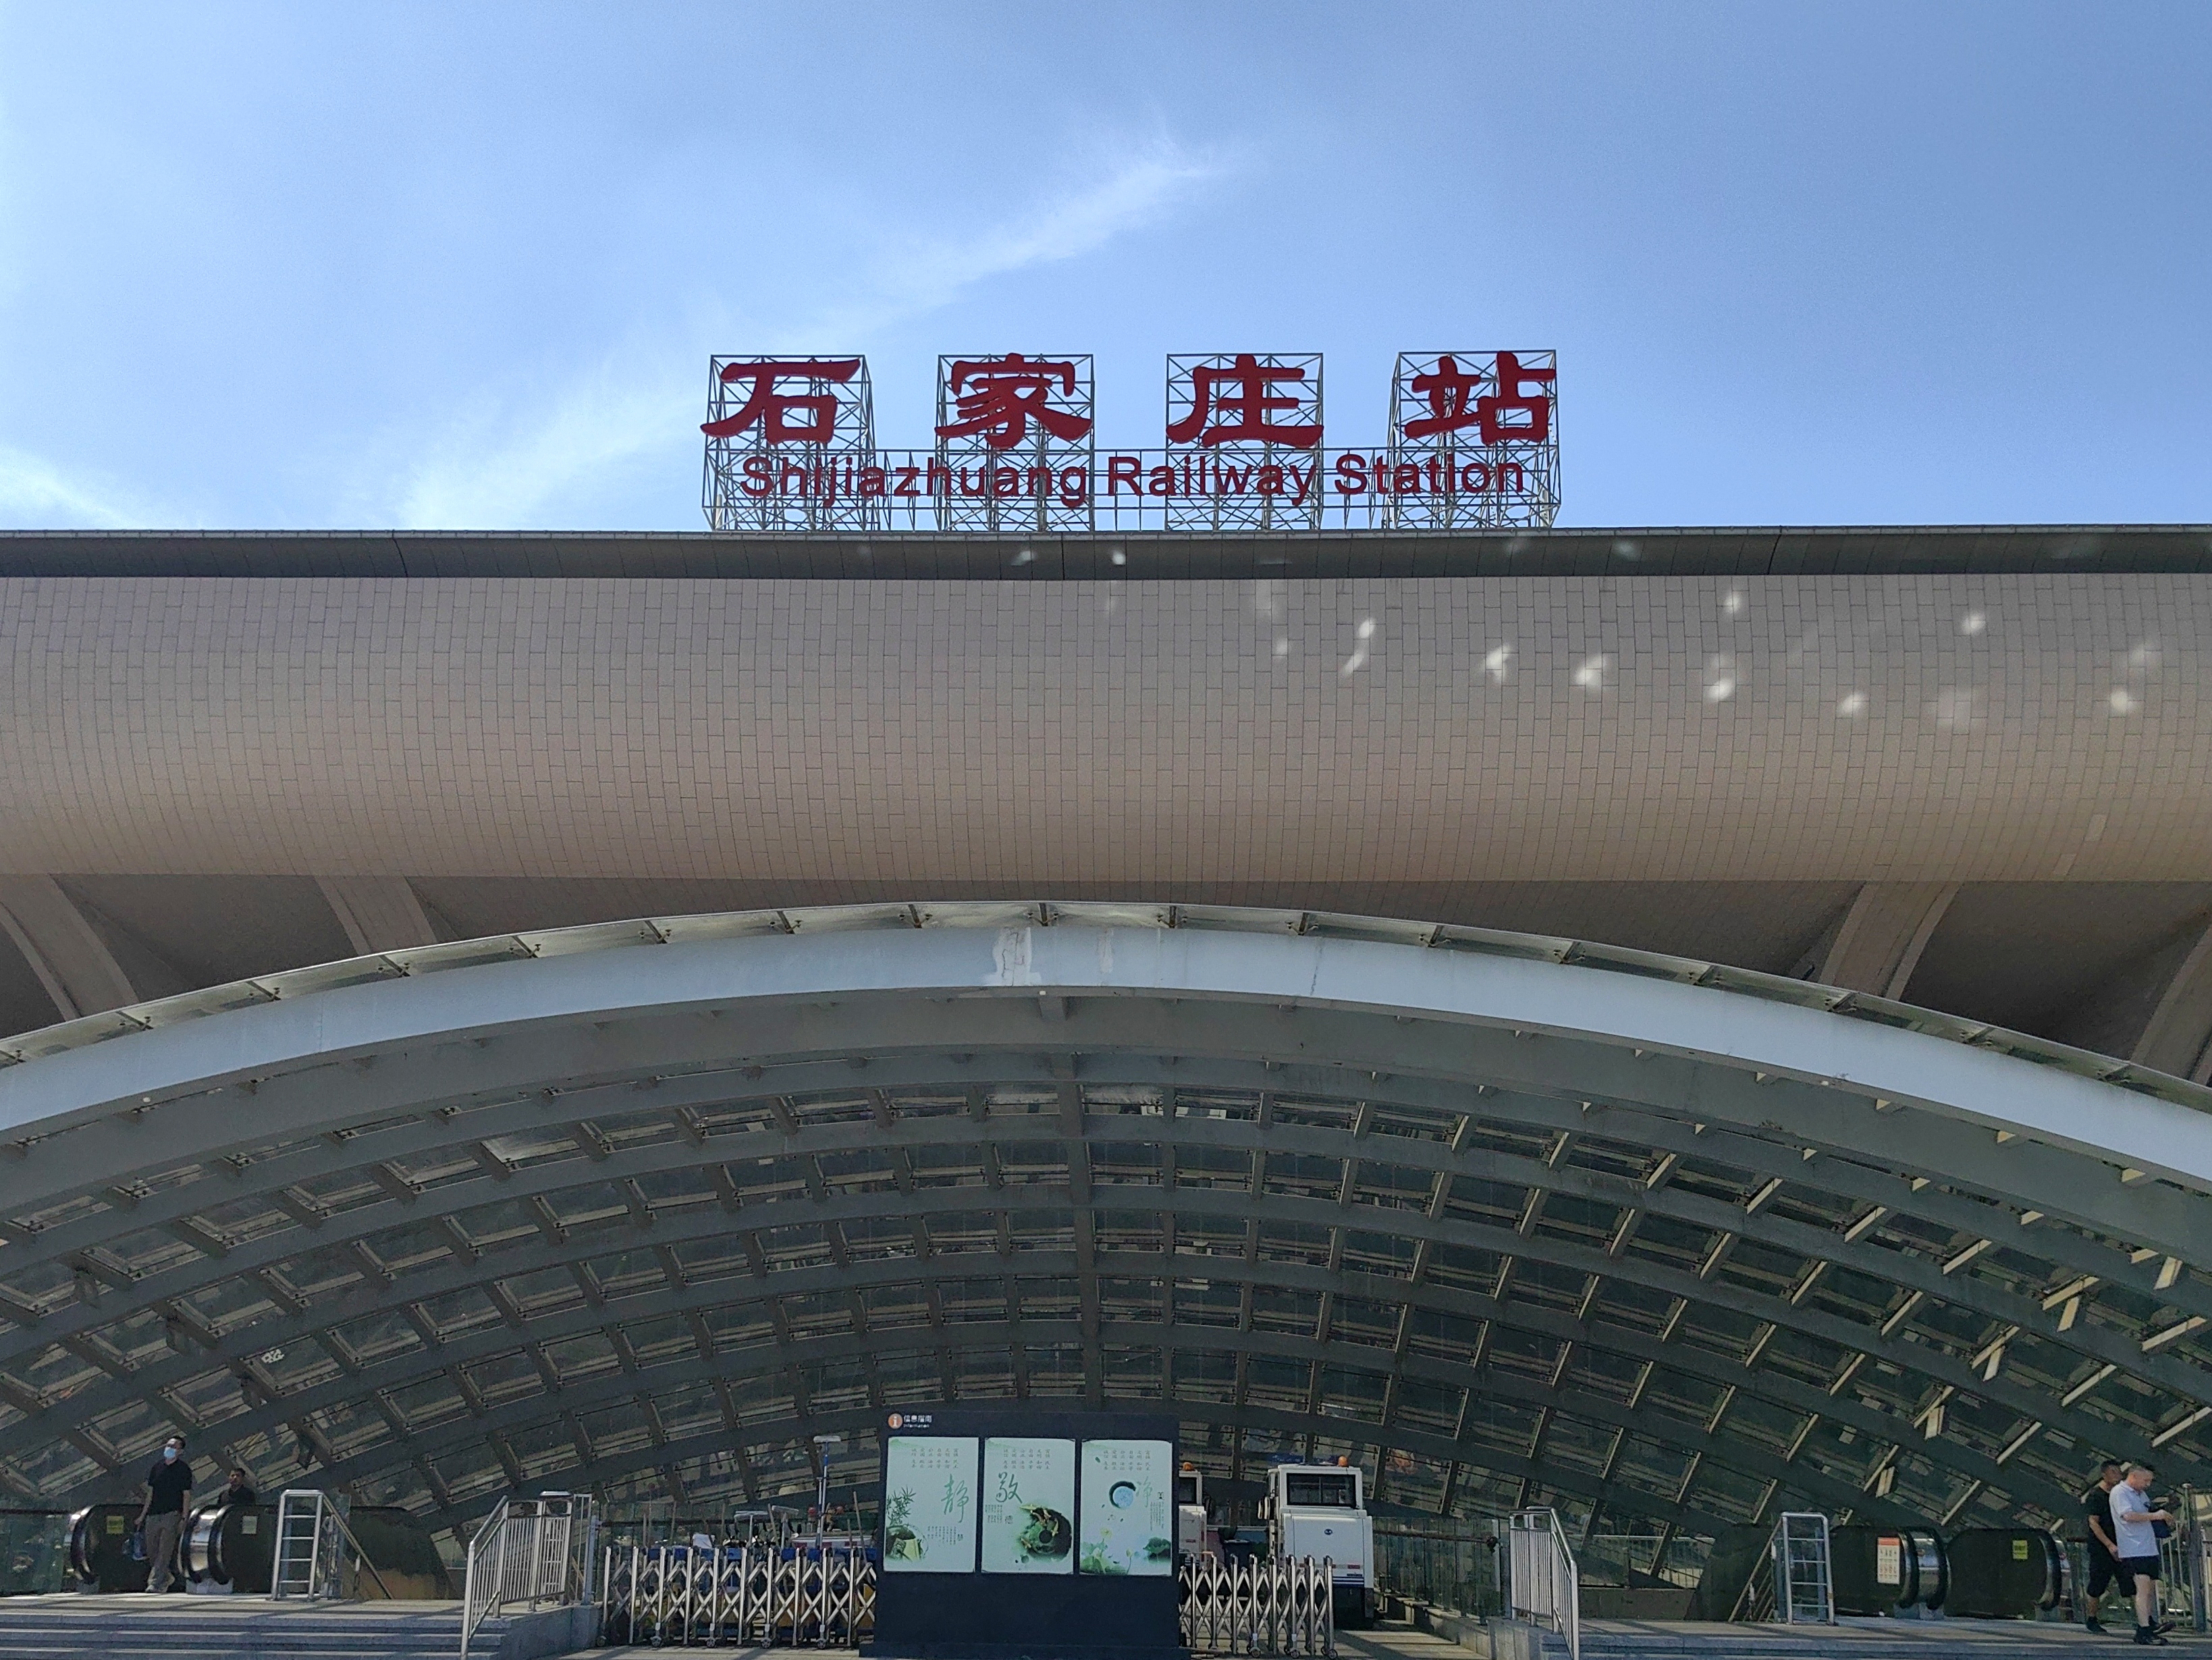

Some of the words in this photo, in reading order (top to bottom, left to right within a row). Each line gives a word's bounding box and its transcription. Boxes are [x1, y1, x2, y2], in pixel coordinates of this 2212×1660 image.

[700, 352, 1557, 450] 石家庄站
[740, 456, 1087, 508] Shijiazhuang
[1108, 456, 1316, 506] Railway
[1334, 454, 1524, 496] Station
[940, 1473, 969, 1524] 静
